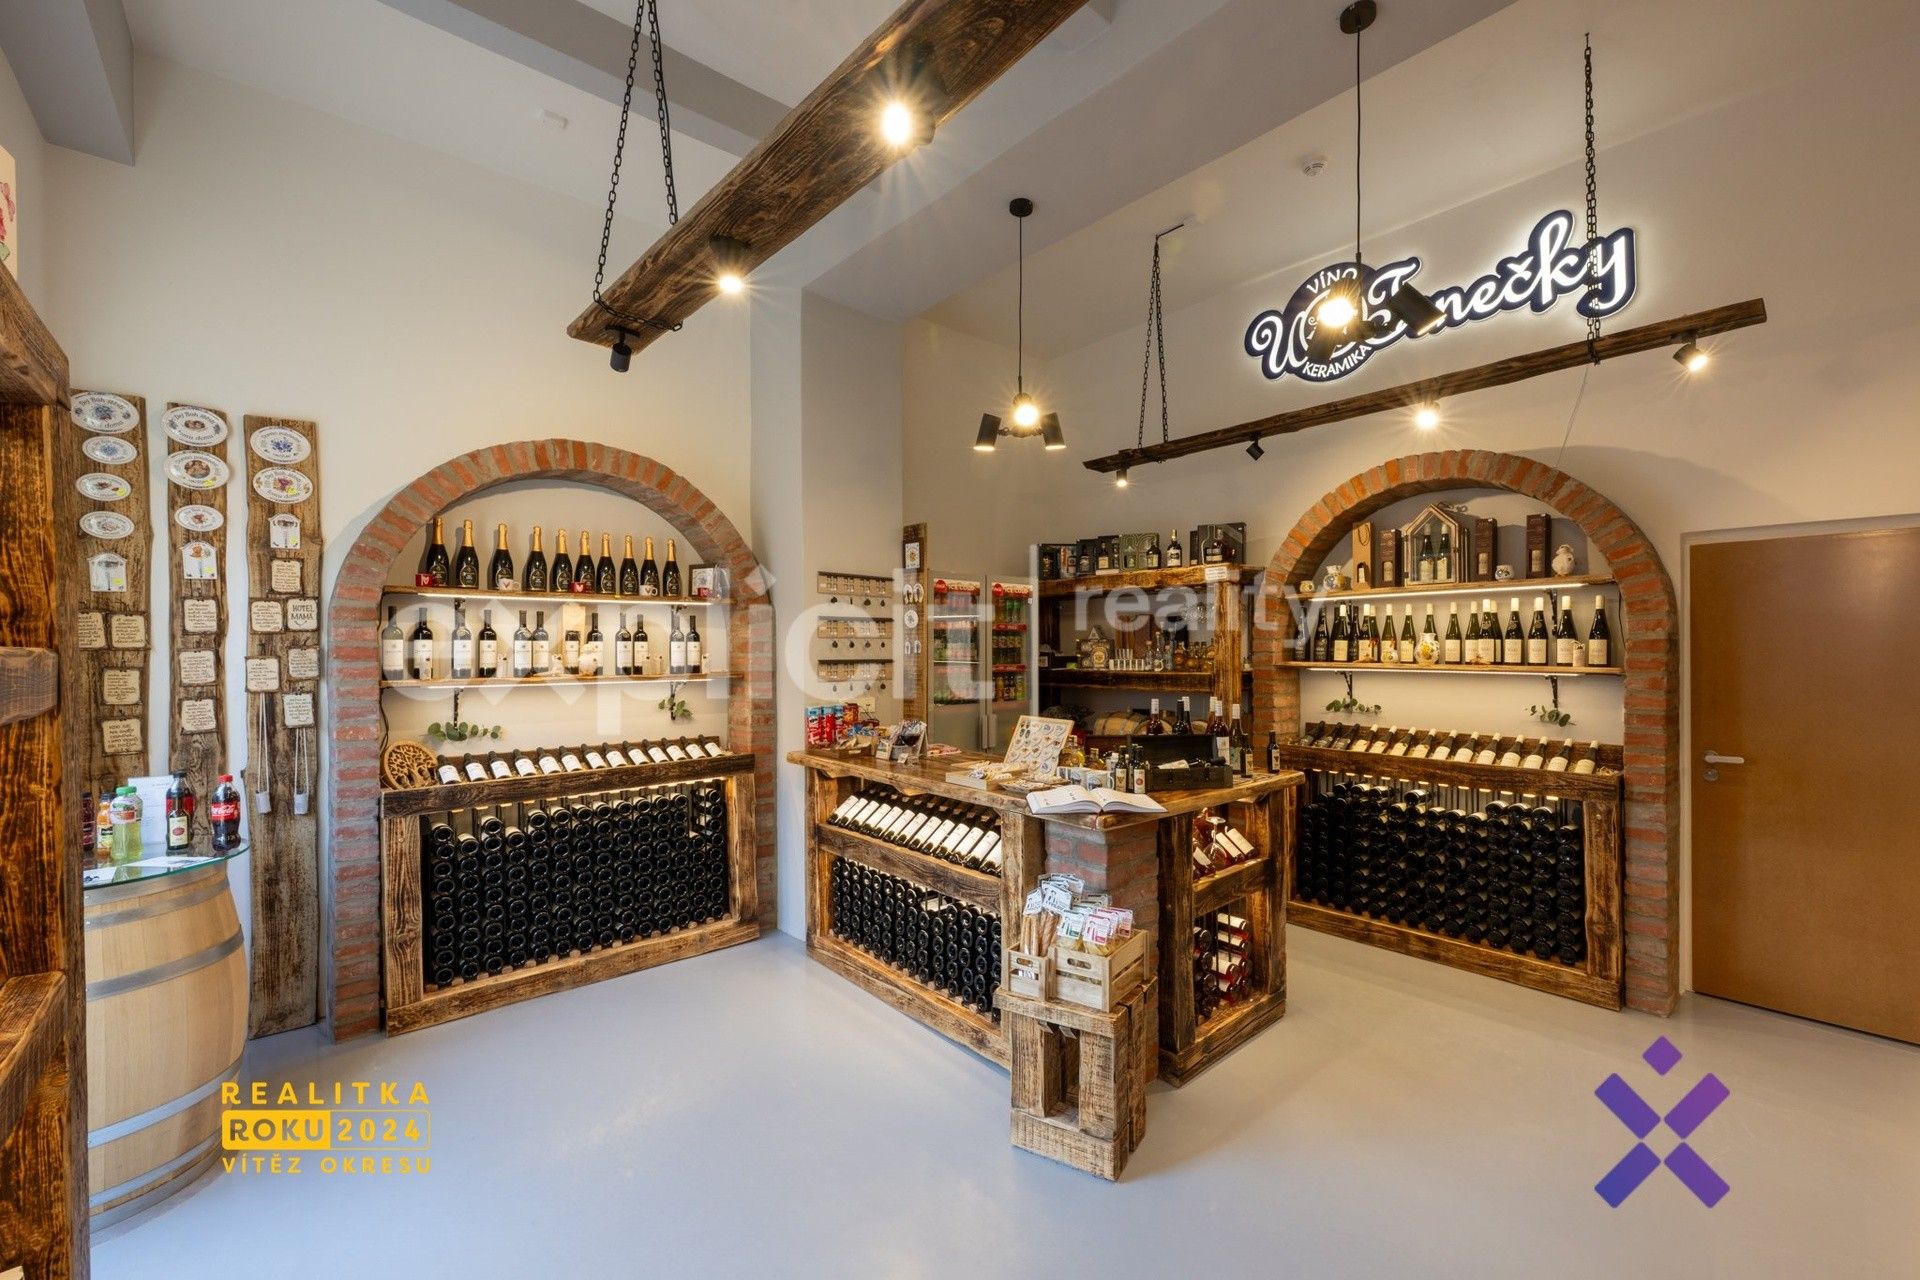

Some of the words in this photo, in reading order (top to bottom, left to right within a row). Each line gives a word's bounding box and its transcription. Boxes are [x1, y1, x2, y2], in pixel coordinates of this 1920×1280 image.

[1306, 267, 1358, 295] VÍNO
[1302, 344, 1373, 379] KERAMIKA
[291, 612, 313, 621] MAMA
[292, 604, 314, 613] HOTEL
